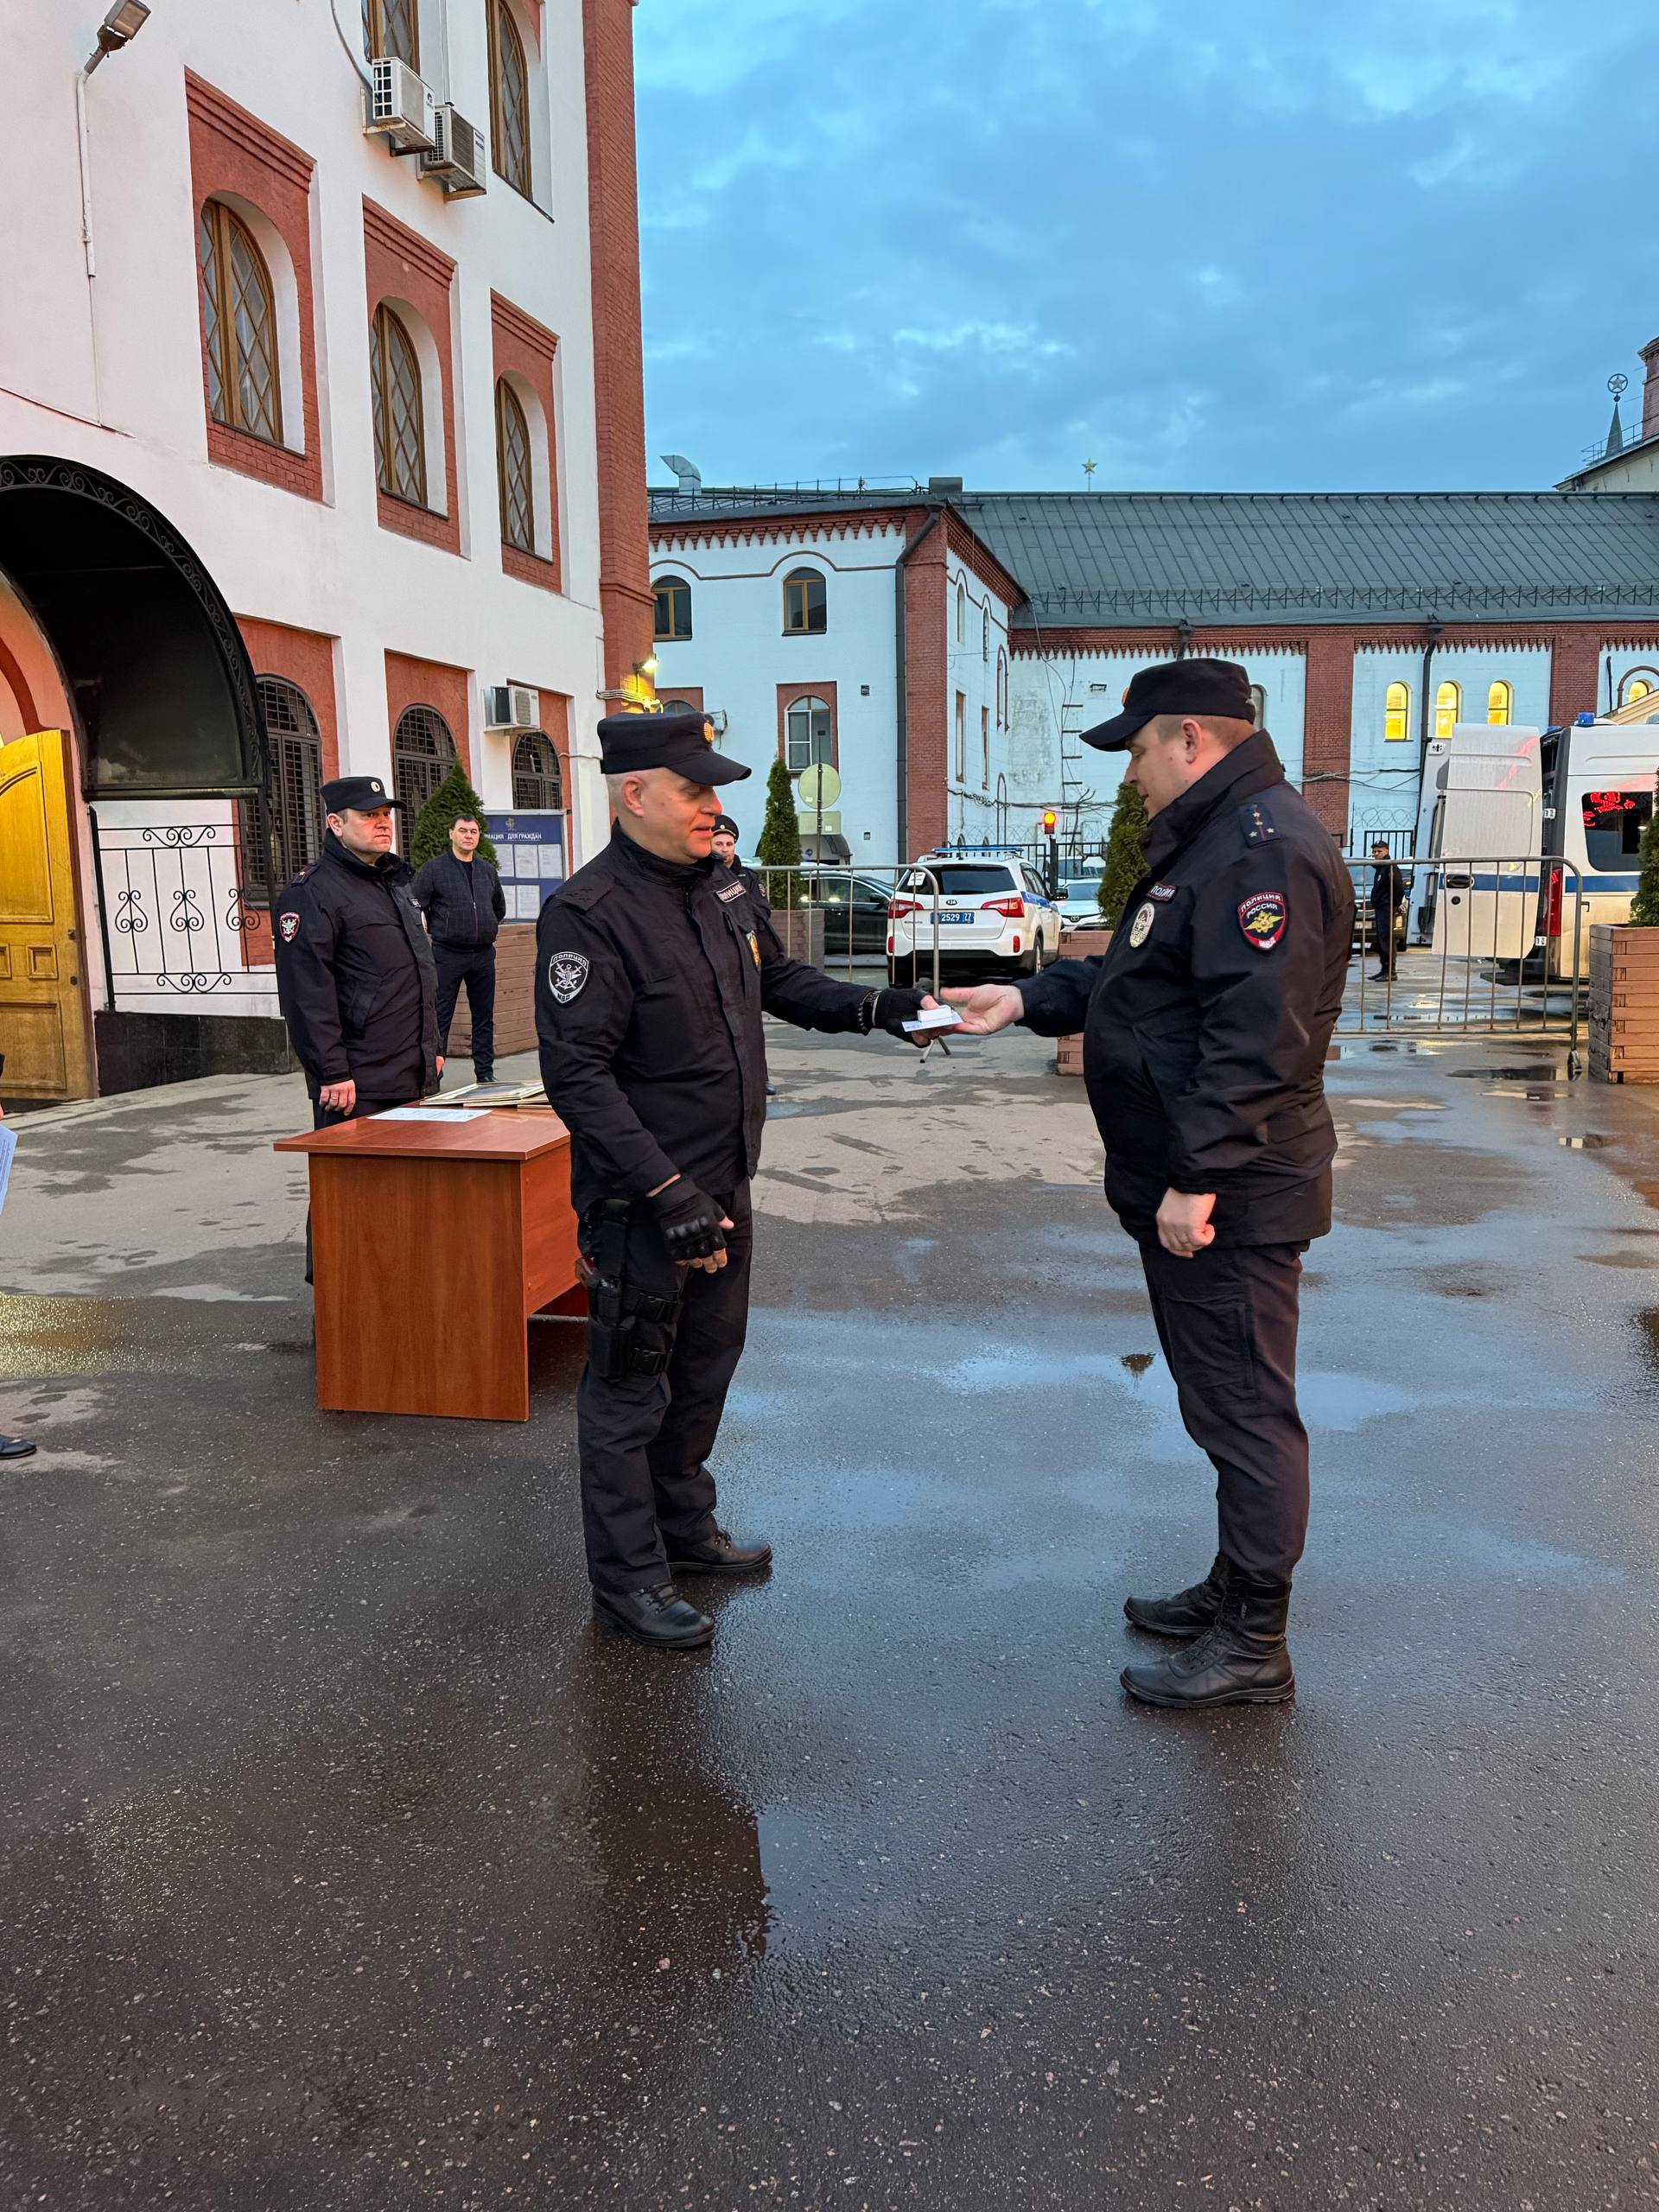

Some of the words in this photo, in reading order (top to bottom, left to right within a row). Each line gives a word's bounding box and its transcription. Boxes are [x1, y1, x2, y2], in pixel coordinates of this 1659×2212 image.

[1241, 893, 1281, 912] ПОЛИЦИЯ
[941, 913, 960, 922] 2529
[1247, 903, 1278, 918] РОССИЯ
[553, 953, 587, 967] ПОЛИЦИЯ
[556, 993, 570, 1002] МВД
